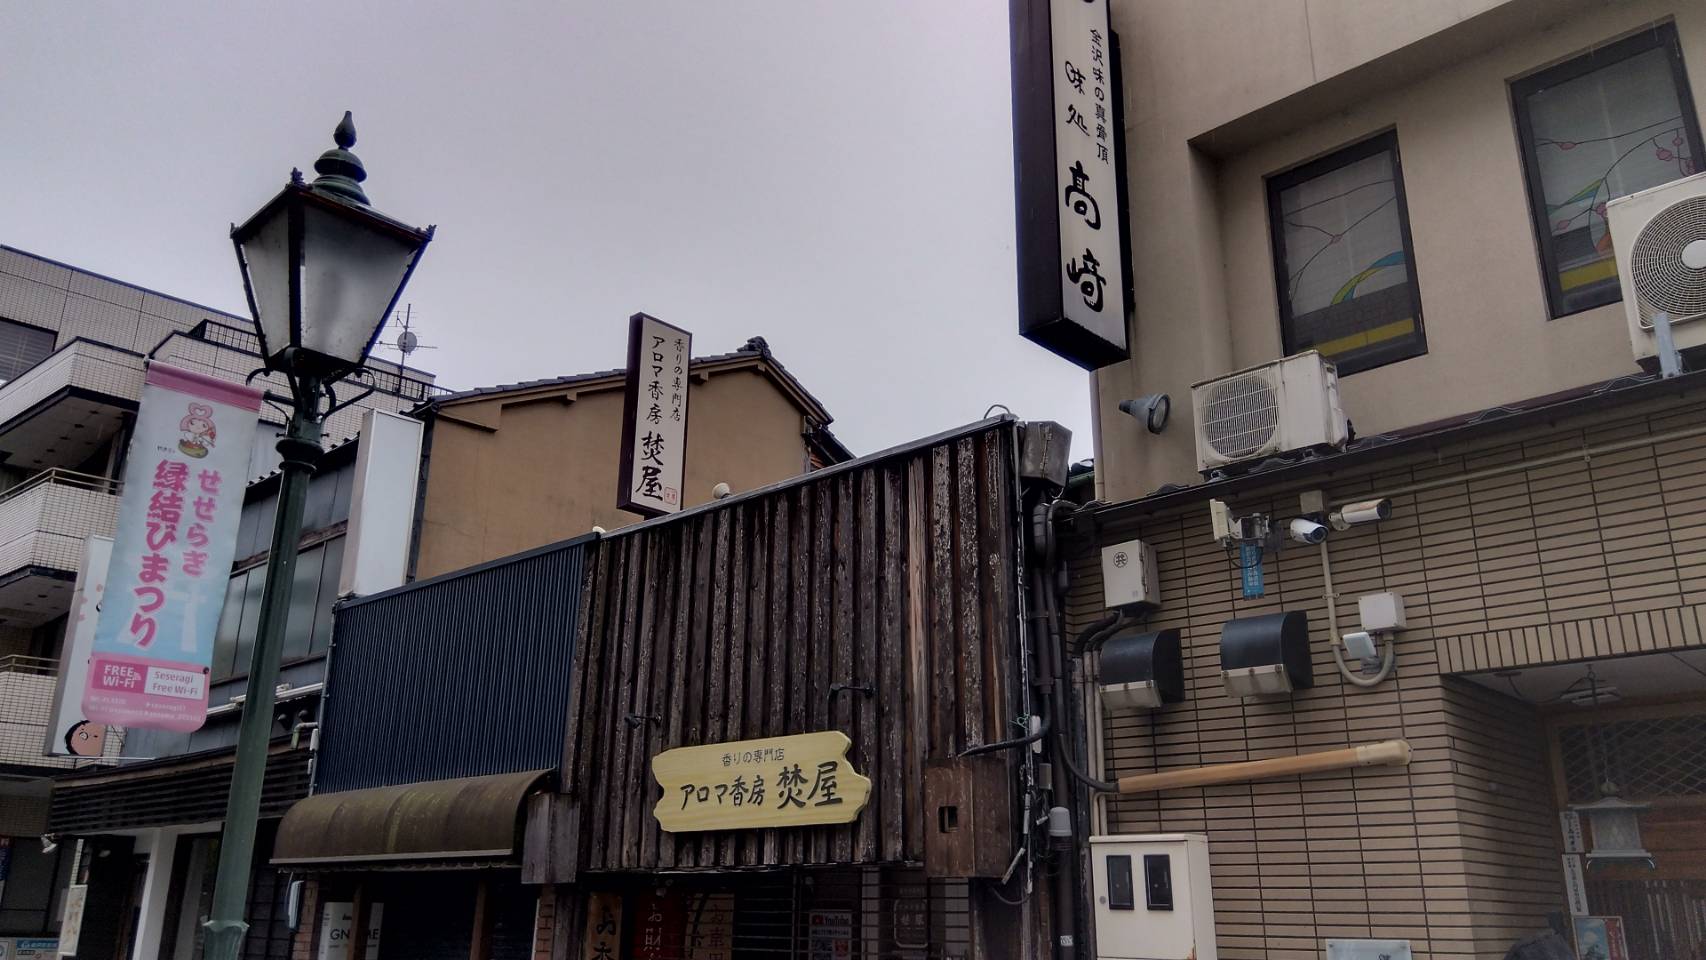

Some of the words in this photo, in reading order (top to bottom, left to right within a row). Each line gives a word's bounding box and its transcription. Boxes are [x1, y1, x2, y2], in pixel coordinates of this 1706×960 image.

[670, 338, 685, 423] 香りの専門店
[182, 468, 223, 577] せせらぎ
[130, 459, 189, 647] 縁結びまつり
[104, 664, 134, 678] FREE
[154, 671, 194, 684] Seseragi
[103, 675, 135, 688] Wi-Fi
[152, 682, 174, 693] Free
[174, 684, 198, 695] Wi-Fi
[721, 748, 785, 768] 香りの専門店
